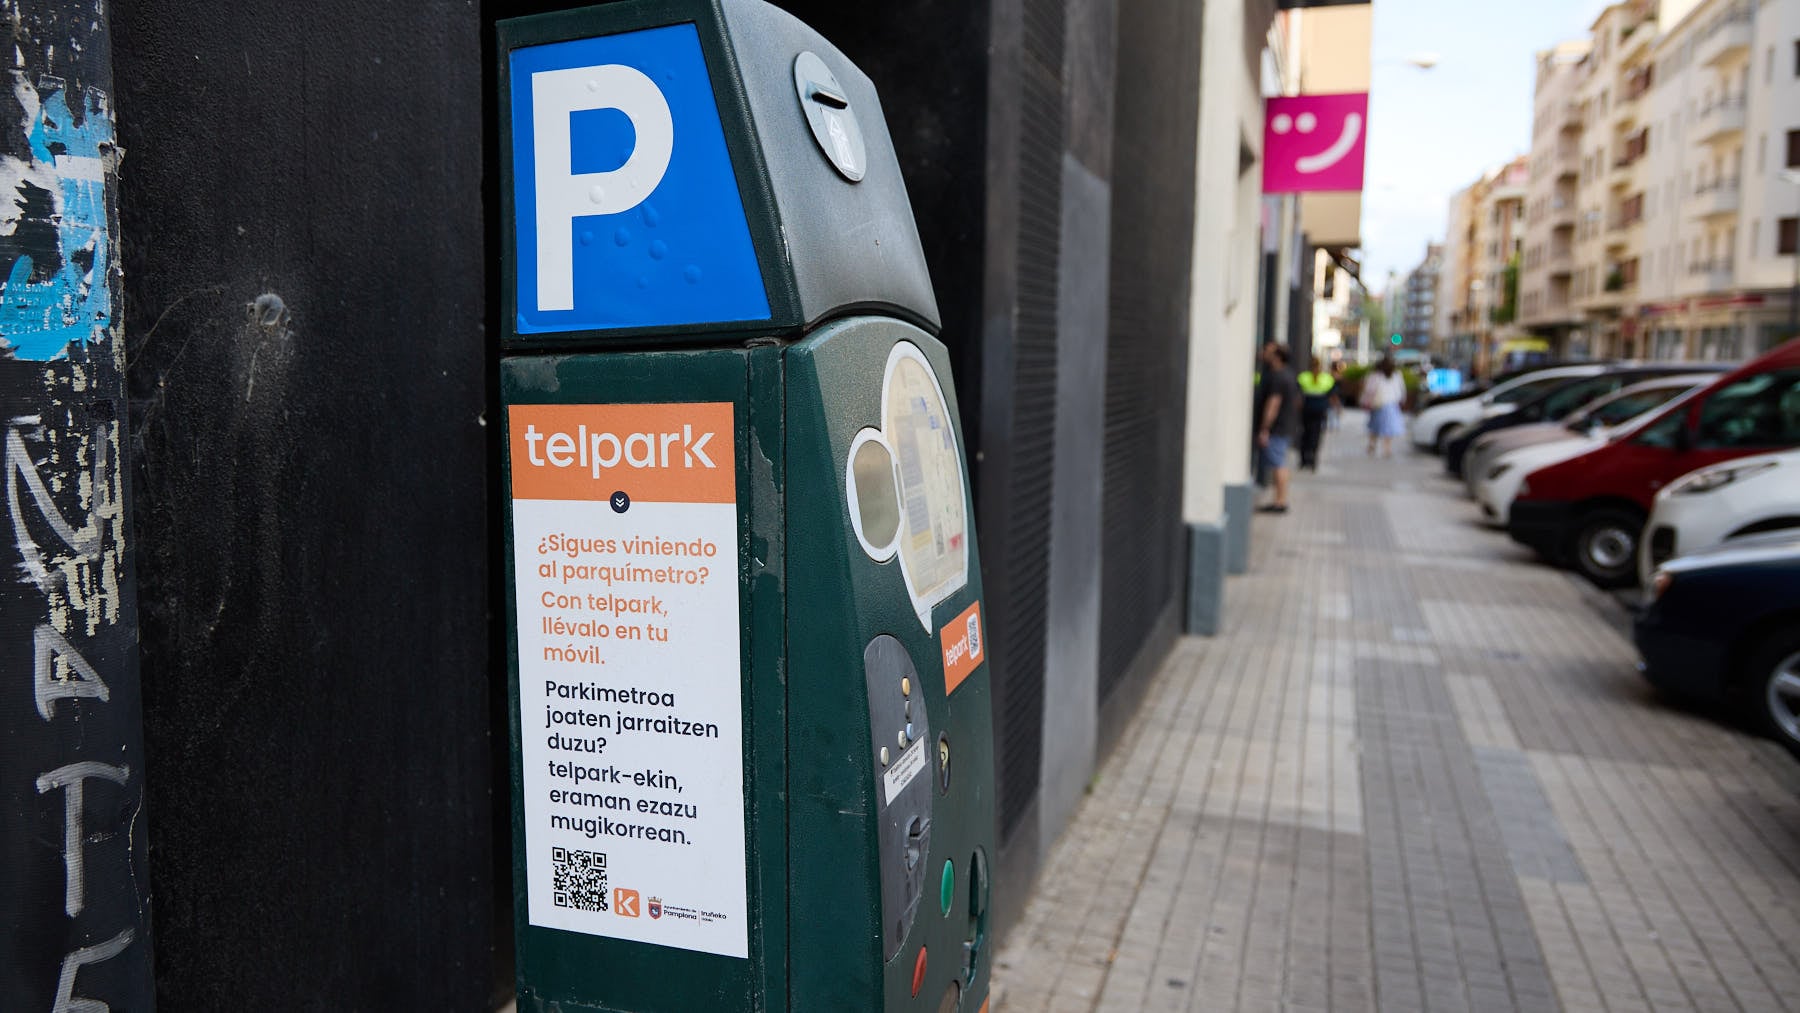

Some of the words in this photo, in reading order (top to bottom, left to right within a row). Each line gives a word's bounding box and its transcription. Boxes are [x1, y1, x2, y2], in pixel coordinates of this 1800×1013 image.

[532, 63, 674, 312] P
[524, 424, 717, 479] telpark
[537, 533, 617, 558] ¿Sigues
[622, 535, 717, 557] viniendo
[538, 561, 557, 578] al
[562, 563, 709, 587] parquímetro?
[541, 591, 582, 610] Con
[586, 593, 668, 618] telpark,
[542, 616, 610, 639] llévalo
[615, 626, 641, 641] en
[646, 623, 668, 642] tu
[543, 643, 606, 665] móvil.
[545, 680, 675, 708] Parkimetroa
[545, 704, 611, 729] joaten
[616, 711, 719, 739] jarraitzen
[547, 733, 607, 754] duzu?
[548, 760, 683, 794] telpark-ekin,
[549, 789, 631, 812] eraman
[636, 799, 697, 819] ezazu
[550, 814, 692, 846] mugikorrean.
[663, 909, 697, 920] Pamplona
